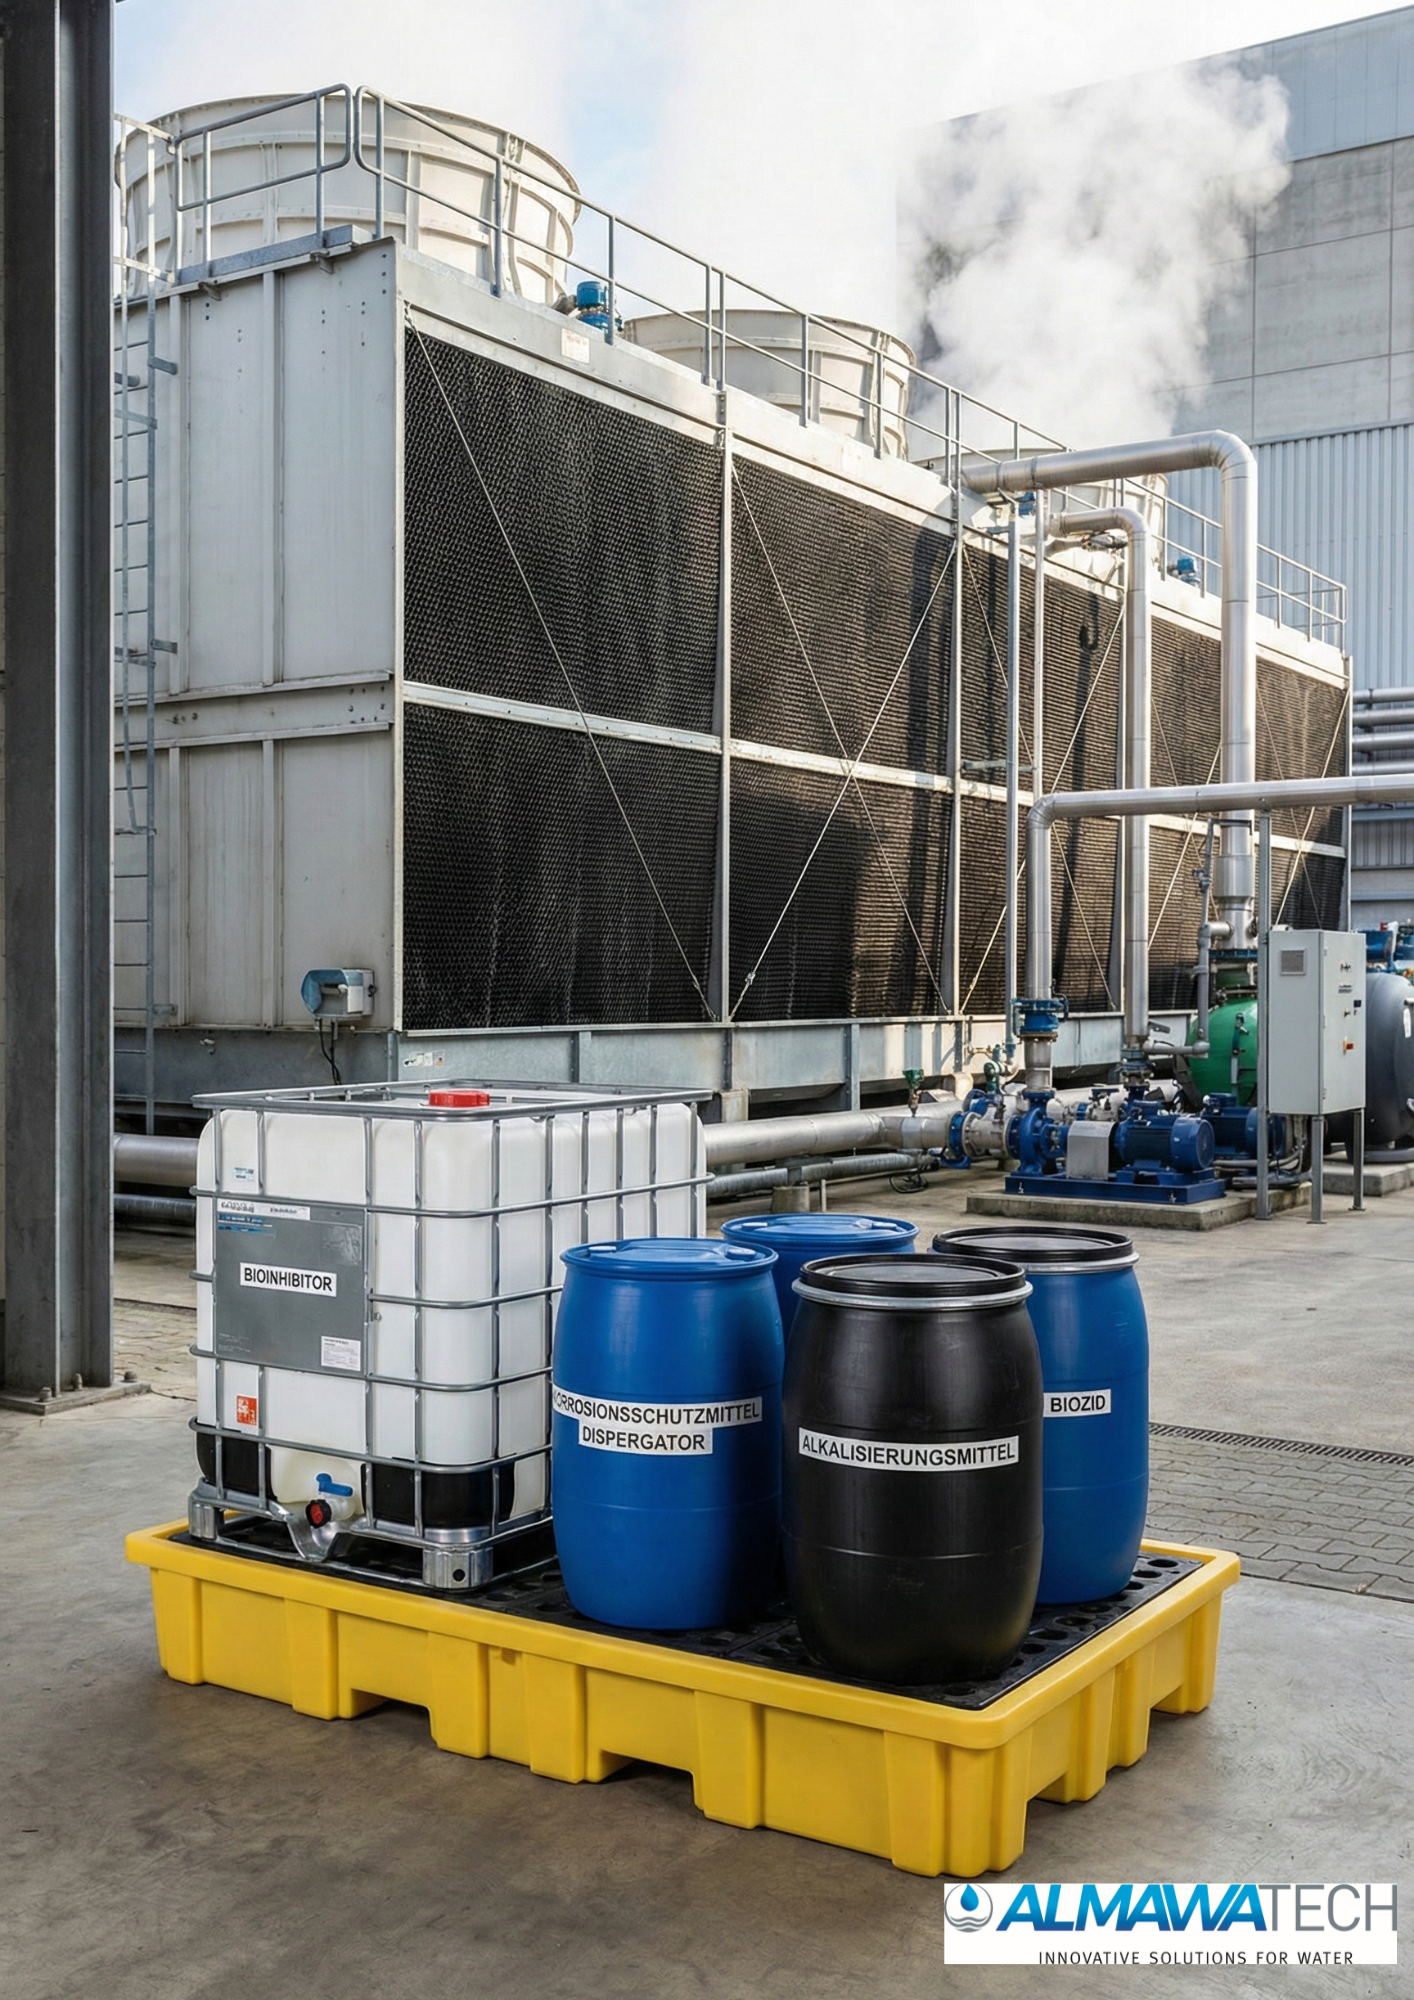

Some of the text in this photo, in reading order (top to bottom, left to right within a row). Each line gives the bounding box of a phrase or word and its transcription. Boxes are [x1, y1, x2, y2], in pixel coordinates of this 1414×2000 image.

[244, 1267, 332, 1291] BIOINHIBITOR
[1050, 1395, 1106, 1412] BIOZID
[582, 1425, 705, 1450] DISPERGATOR
[802, 1435, 1015, 1466] ALKALISIERUNGSMITTEL
